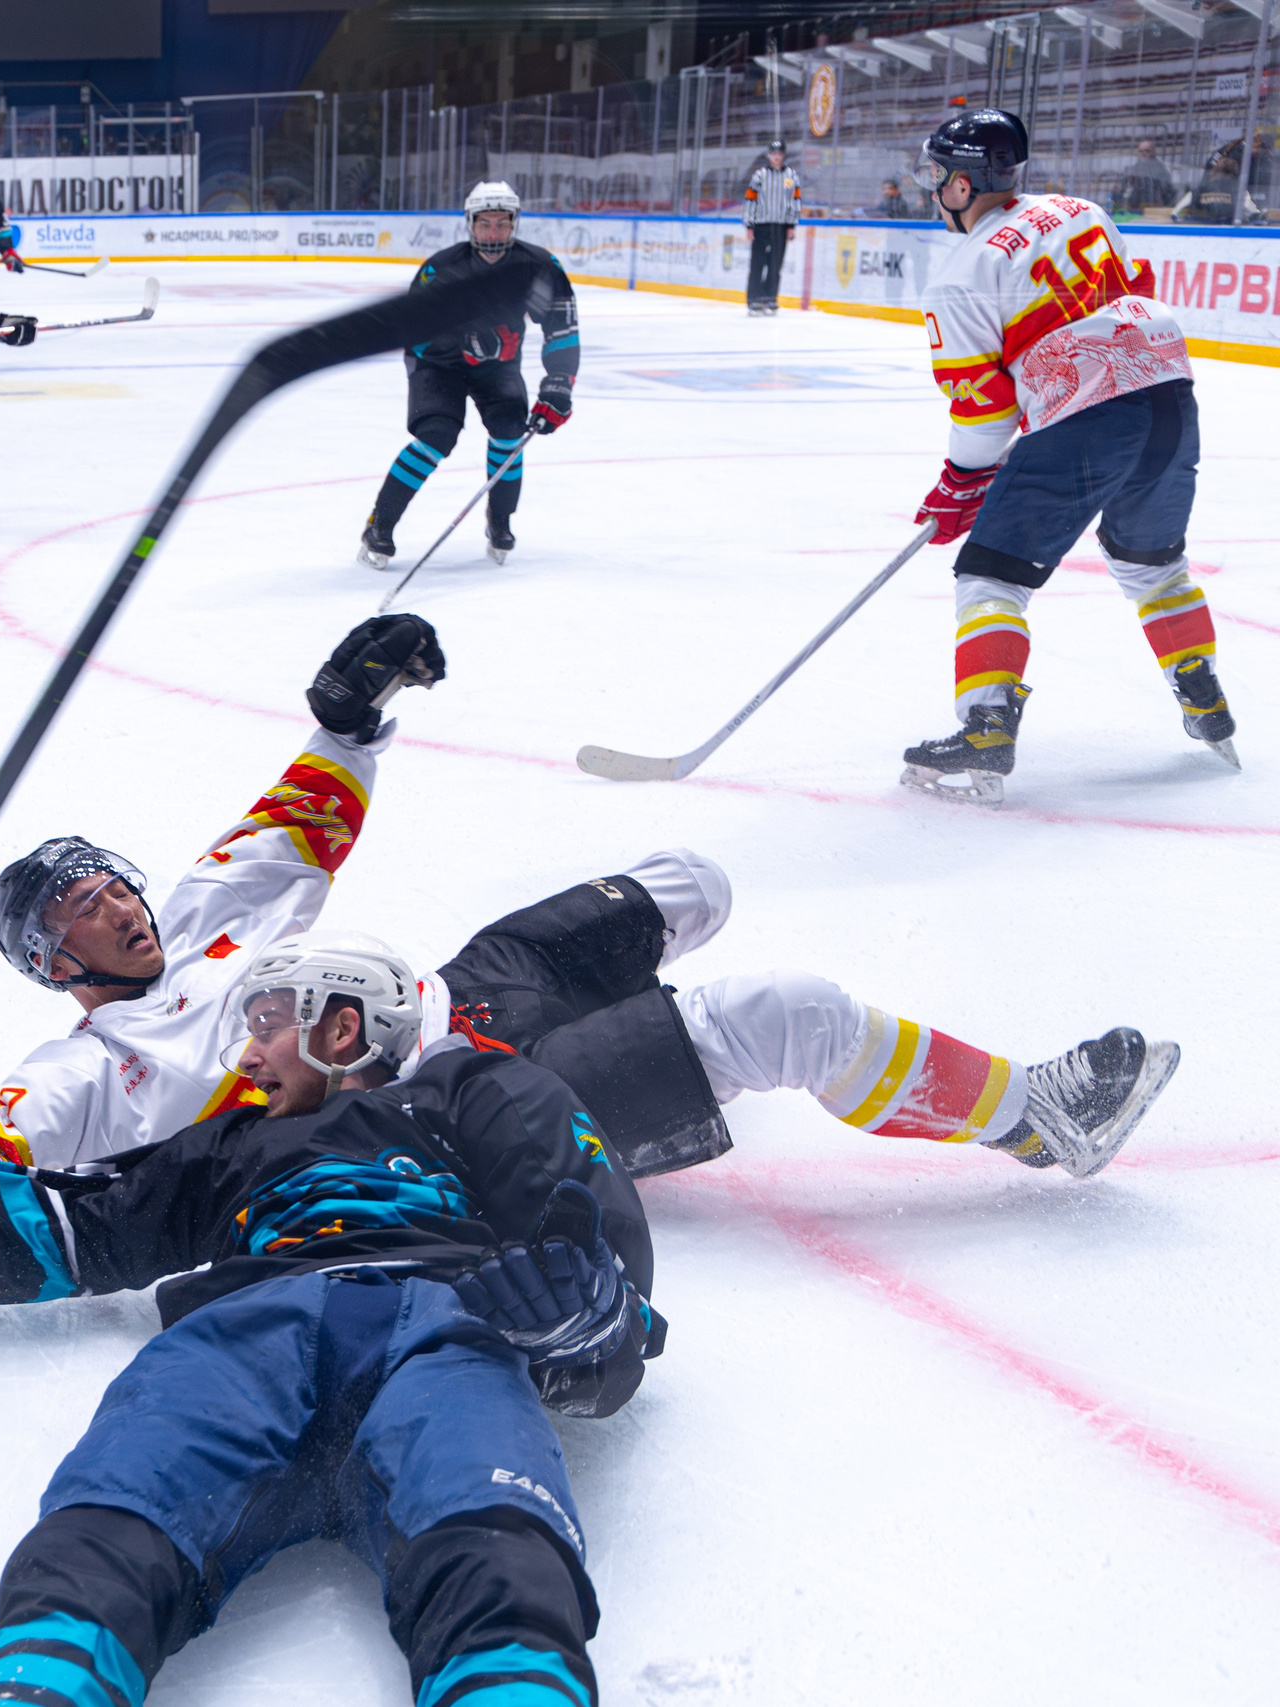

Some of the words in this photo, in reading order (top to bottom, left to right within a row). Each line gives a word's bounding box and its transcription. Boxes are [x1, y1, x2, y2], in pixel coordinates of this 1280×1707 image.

[36, 224, 96, 242] slavda
[297, 232, 376, 247] GISLAVED
[859, 252, 904, 278] БАНК
[1029, 224, 1131, 322] 10
[1160, 259, 1280, 316] IMPB
[321, 971, 367, 985] CCM
